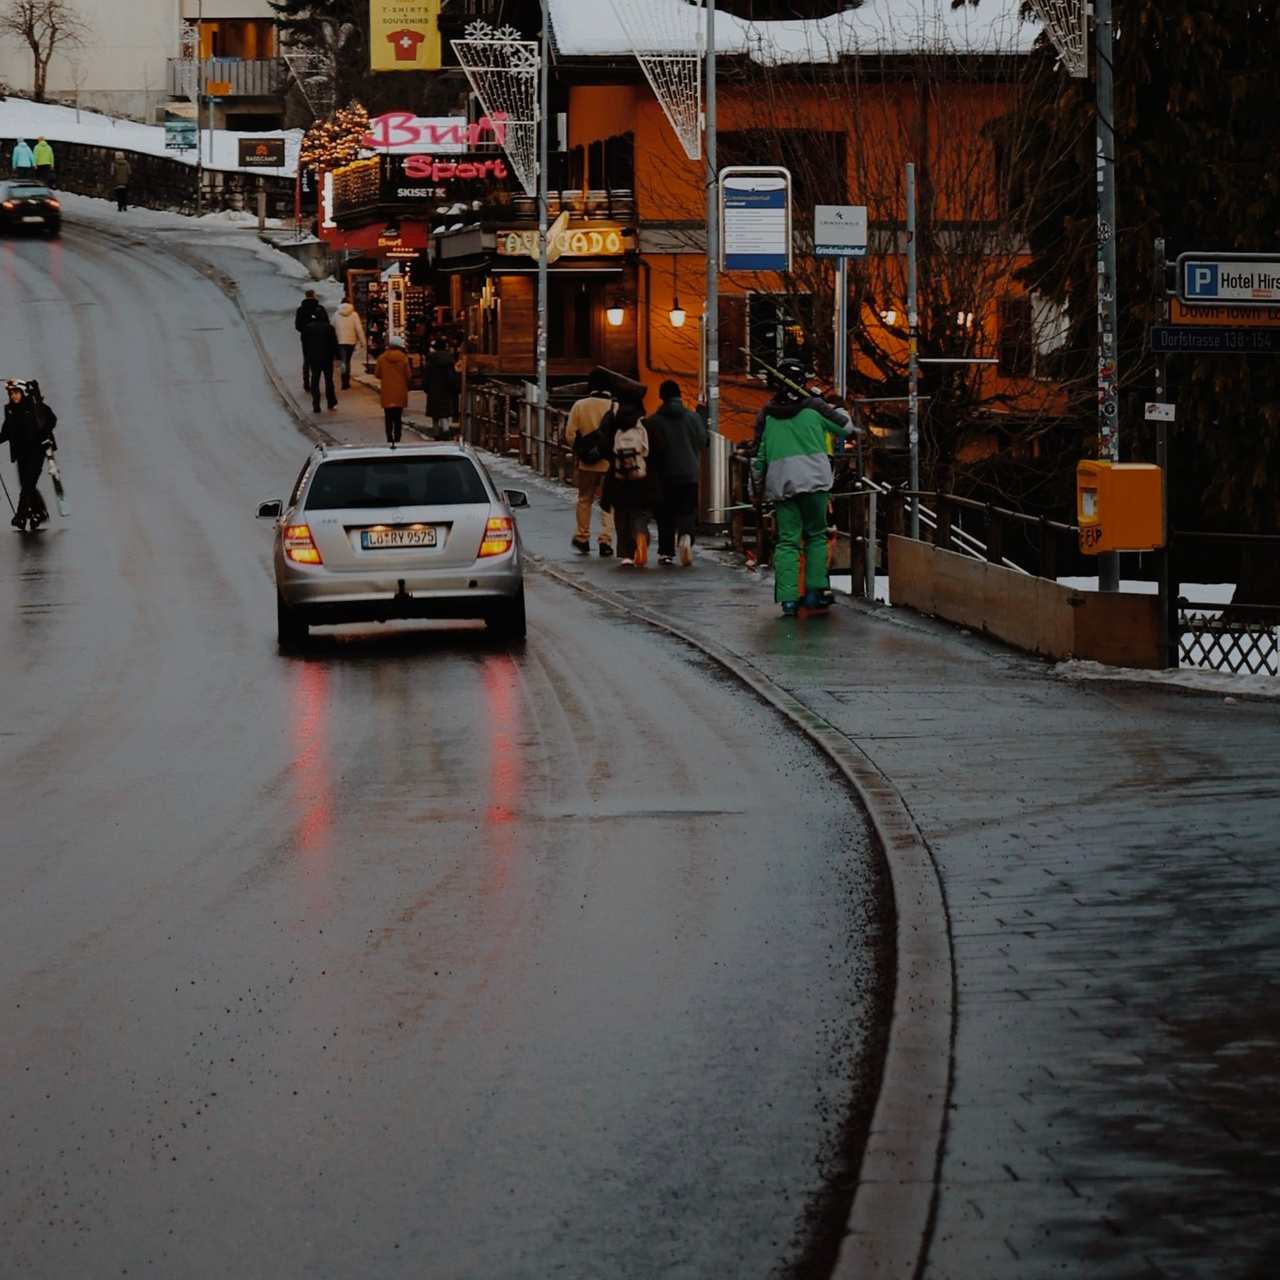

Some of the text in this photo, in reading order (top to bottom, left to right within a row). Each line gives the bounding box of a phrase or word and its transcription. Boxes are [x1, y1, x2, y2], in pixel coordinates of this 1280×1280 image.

[404, 154, 508, 182] Sport
[397, 188, 434, 197] SKISET
[1195, 268, 1211, 293] P
[1221, 273, 1254, 289] Hotel
[1161, 331, 1220, 347] Dorfstrasse
[390, 531, 404, 543] RY
[407, 530, 434, 543] 9575
